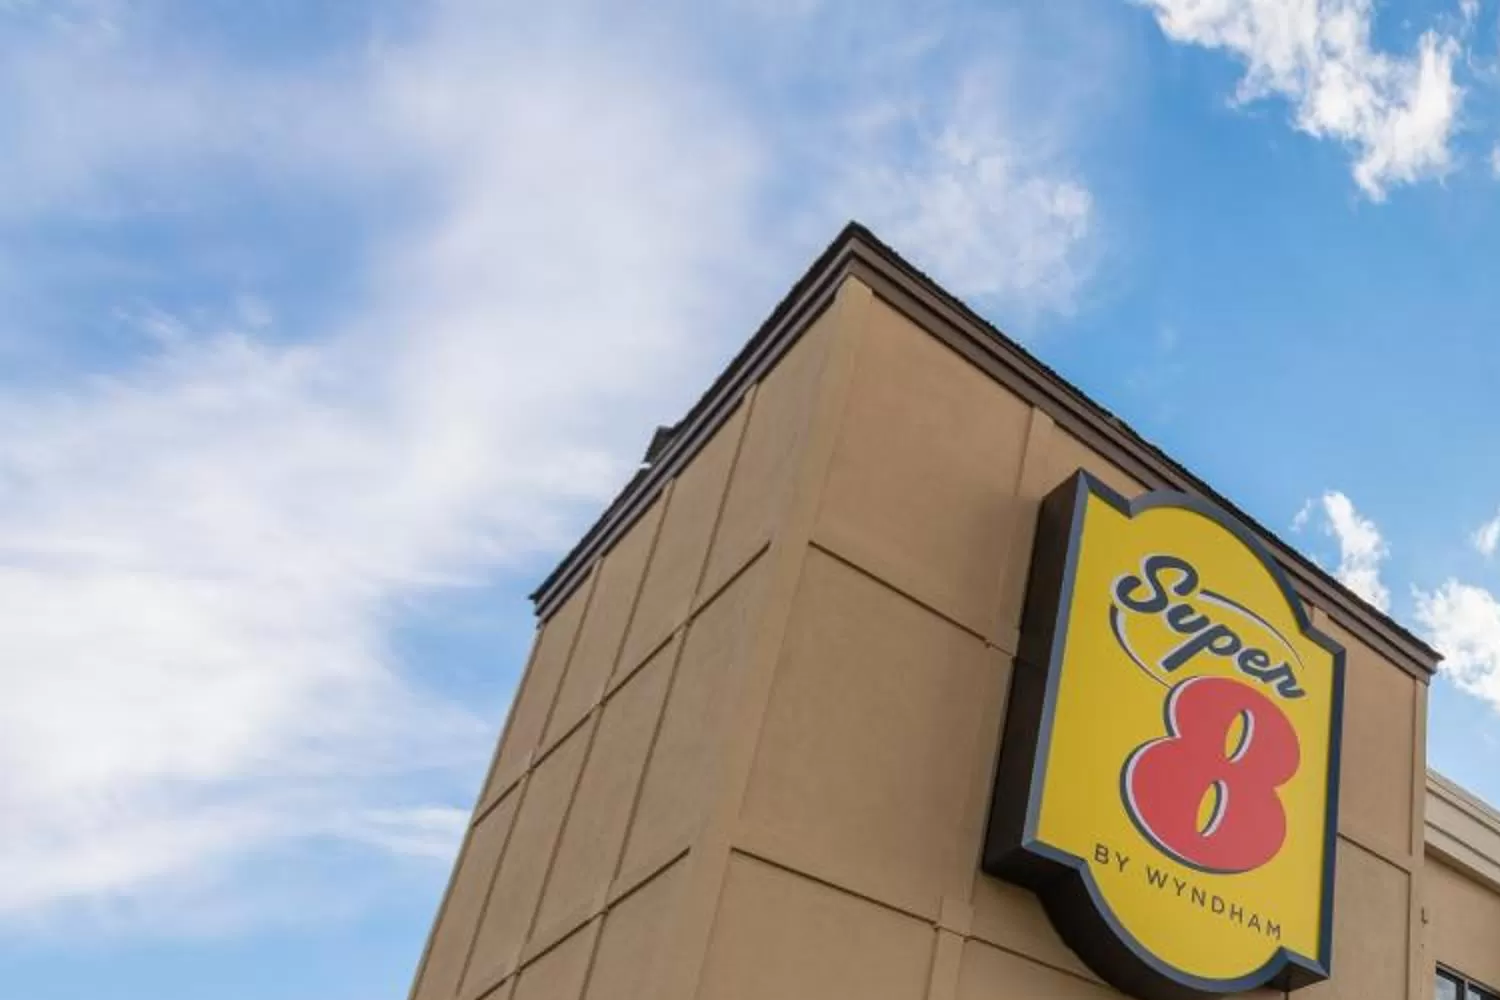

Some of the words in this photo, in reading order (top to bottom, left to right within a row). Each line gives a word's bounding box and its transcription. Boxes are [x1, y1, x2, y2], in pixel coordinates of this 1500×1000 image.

[1112, 554, 1307, 700] Super
[1120, 675, 1300, 875] 8
[1094, 843, 1130, 872] BY
[1146, 864, 1281, 940] WYNDHAM
